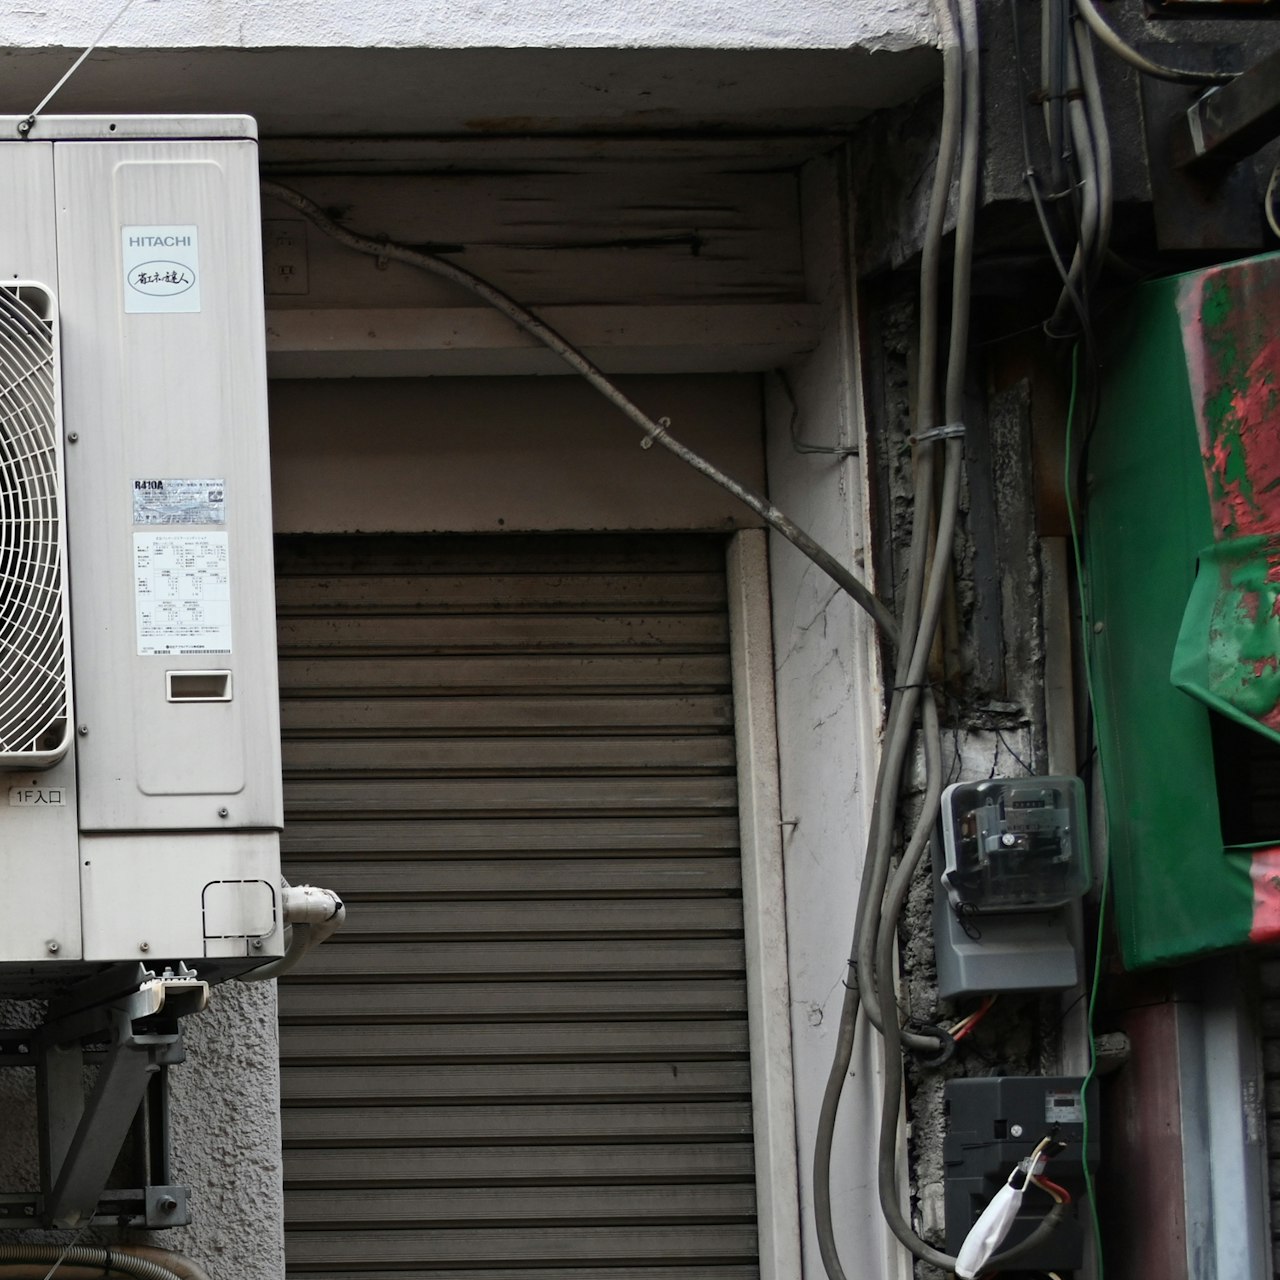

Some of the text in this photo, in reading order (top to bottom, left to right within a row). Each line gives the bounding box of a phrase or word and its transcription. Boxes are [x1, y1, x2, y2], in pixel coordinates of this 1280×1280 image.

[129, 236, 191, 247] HITACHI
[134, 270, 189, 285] 省エネの達人
[134, 480, 164, 490] R410A
[16, 790, 61, 804] 1F入口
